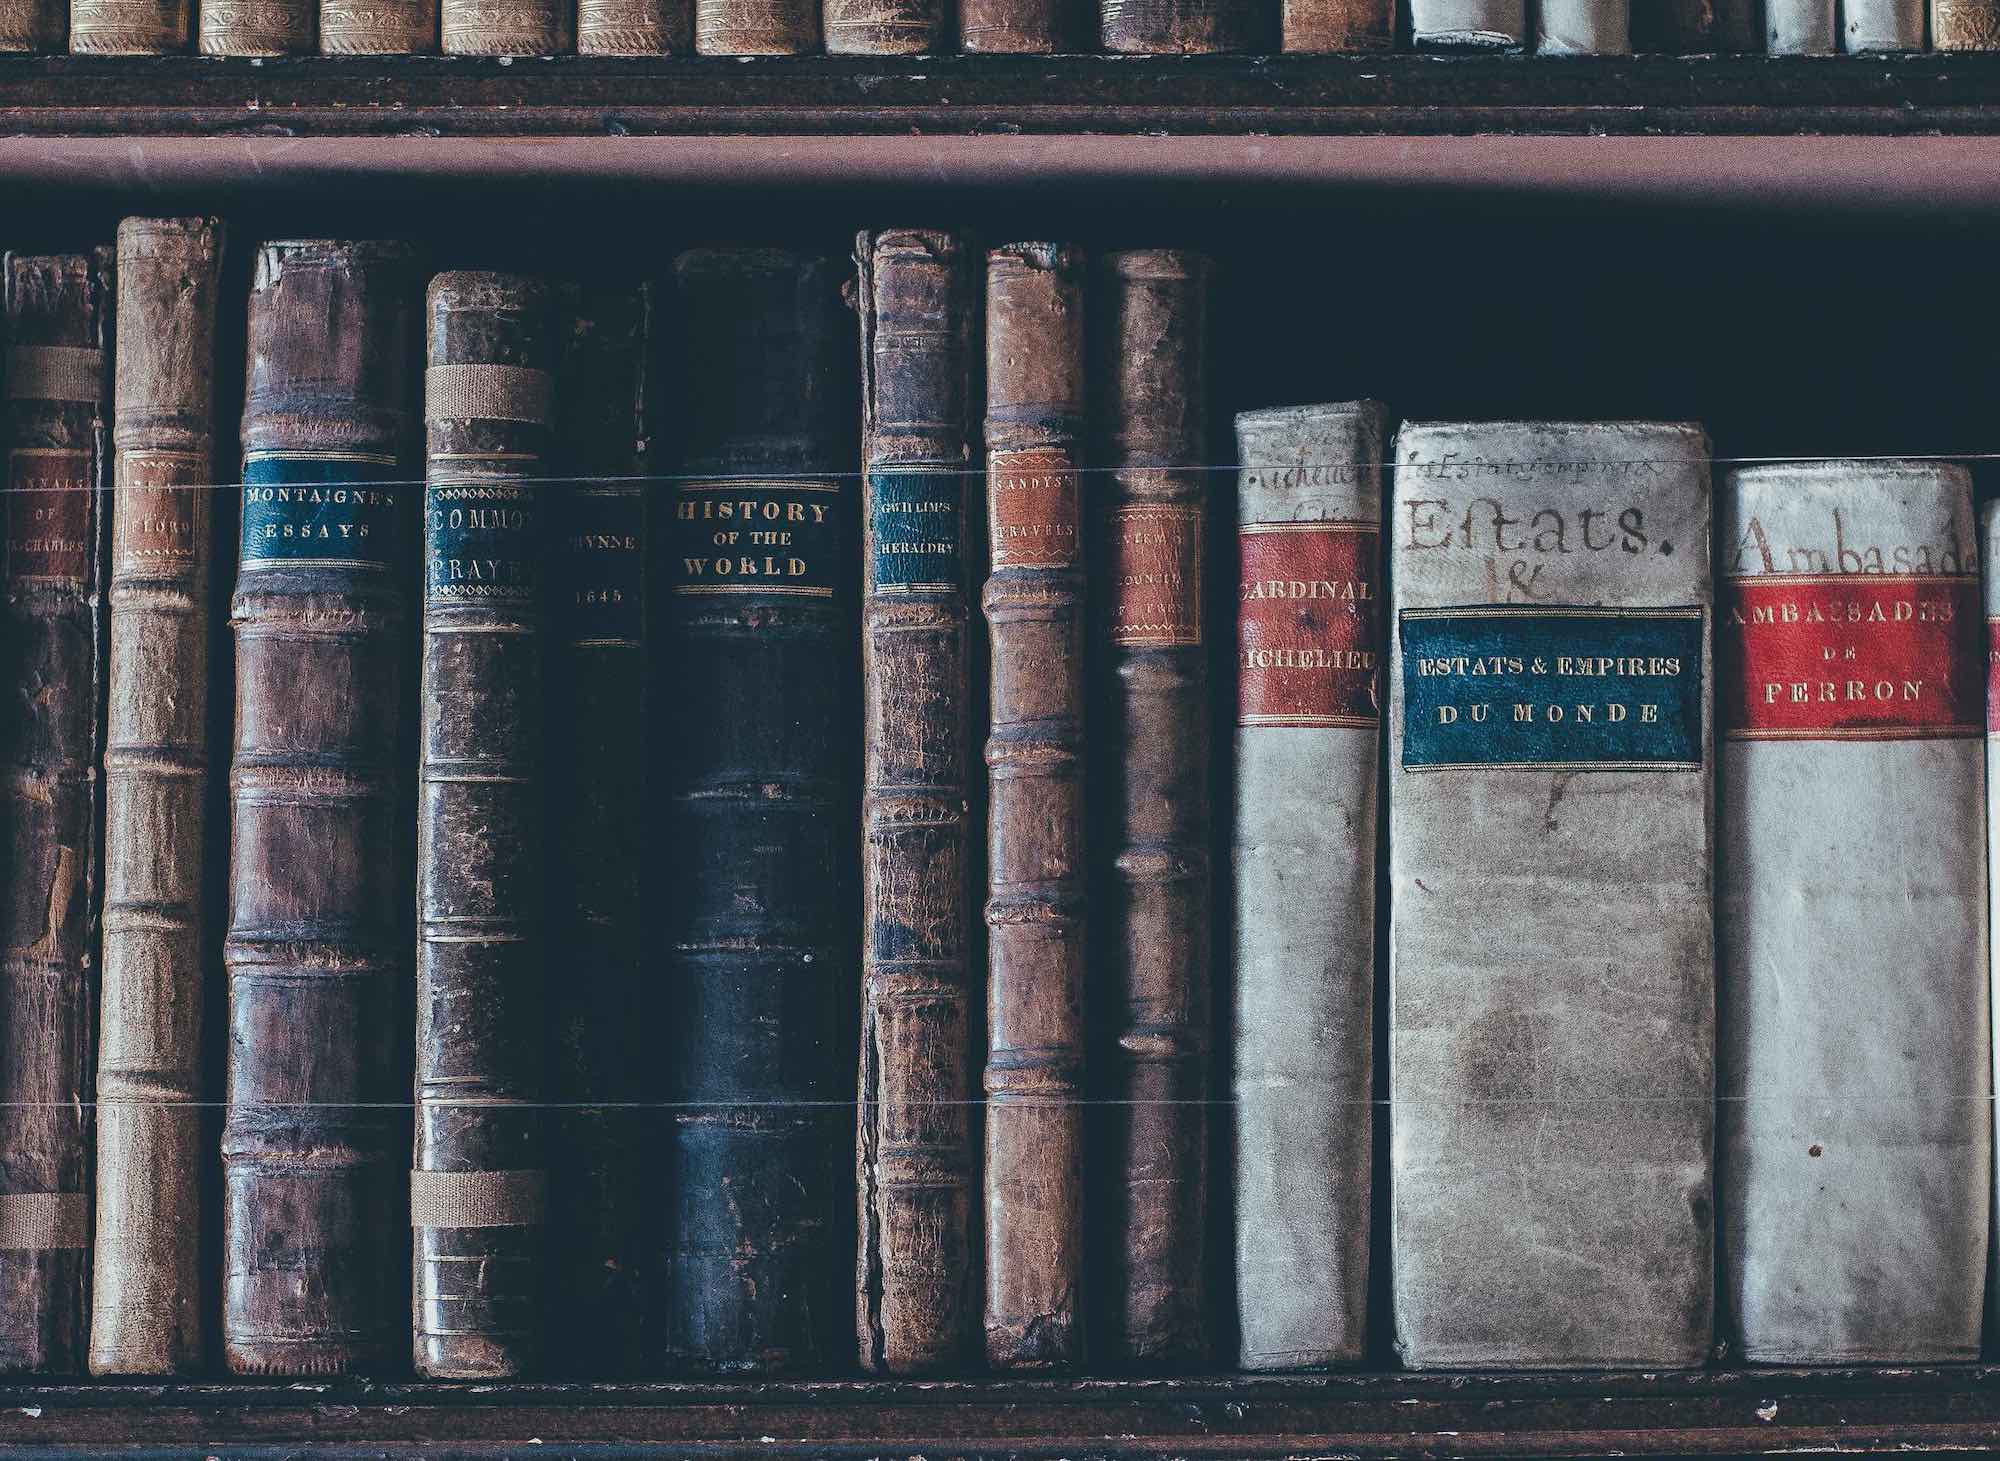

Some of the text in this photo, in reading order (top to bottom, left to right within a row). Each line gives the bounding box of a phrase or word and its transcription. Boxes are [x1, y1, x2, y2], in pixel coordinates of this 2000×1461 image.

[36, 508, 55, 521] OF
[676, 501, 831, 524] HISTORY
[264, 523, 369, 538] ESSAYS
[713, 531, 793, 546] OF THE
[998, 524, 1073, 538] TRAVELS
[881, 542, 953, 555] HERALDRY
[683, 556, 808, 577] WORLD
[1728, 600, 1953, 625] AMBASSADES
[1241, 649, 1376, 670] ICHELIEU
[1823, 647, 1857, 661] DE
[1418, 656, 1681, 677] ESTATS & EMPIRES
[1763, 680, 1923, 704] PERRON
[1439, 704, 1659, 724] DU MONDE
